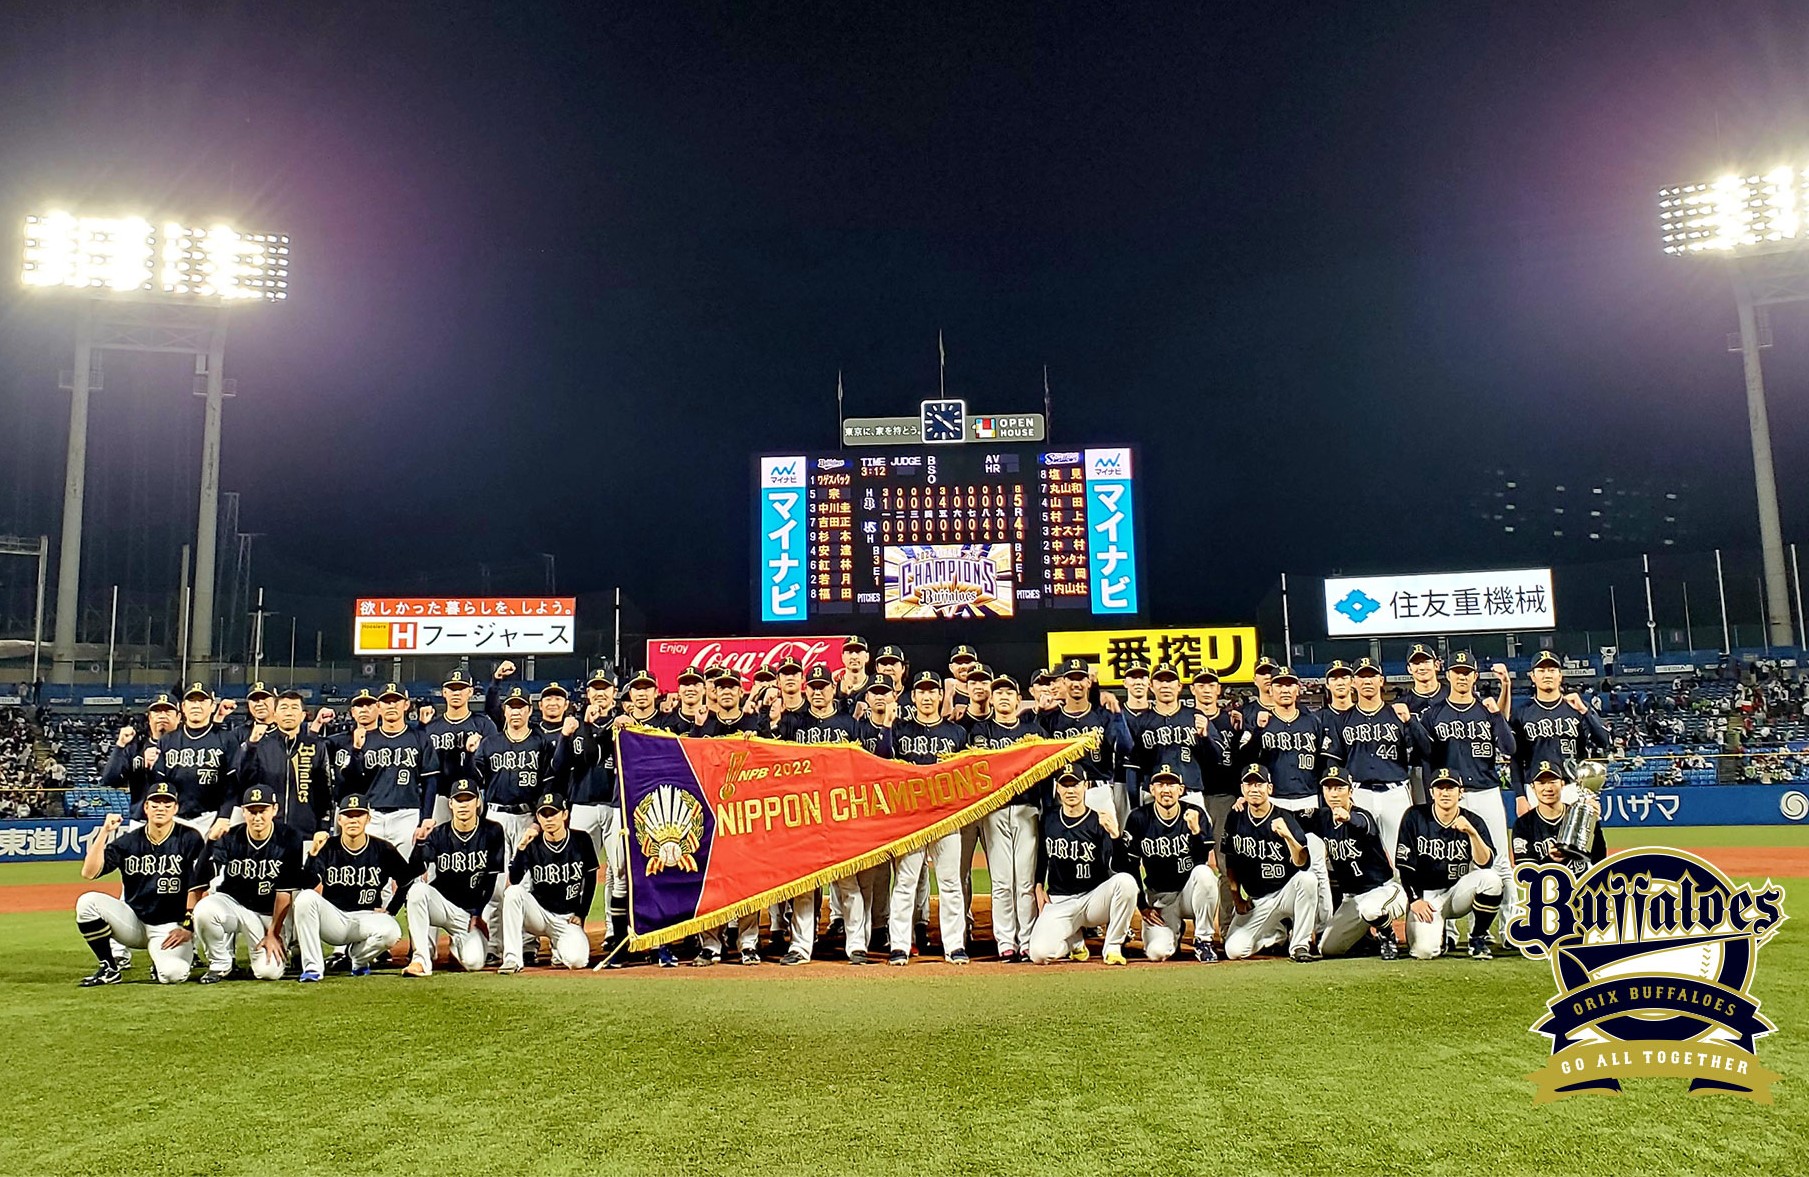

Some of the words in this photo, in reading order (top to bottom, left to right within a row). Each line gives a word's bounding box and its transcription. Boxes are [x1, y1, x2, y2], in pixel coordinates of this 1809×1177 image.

[1000, 418, 1034, 428] OPEN
[845, 426, 921, 438] 東京に、家を持とう。
[1000, 428, 1034, 437] HOUSE
[861, 457, 886, 466] TIME
[890, 456, 921, 465] JUDGE
[927, 456, 936, 465] B
[985, 454, 1000, 463] AV
[861, 467, 886, 476] 3:12
[927, 466, 936, 474] S
[985, 464, 1000, 473] HR
[1040, 470, 1047, 479] 8
[1048, 468, 1083, 480] 塩見
[1095, 468, 1122, 476] マイナビ
[770, 476, 797, 484] マイナビ
[810, 476, 815, 485] 1
[927, 475, 937, 484] O
[810, 490, 816, 499] 5
[828, 488, 840, 499] 宗
[1041, 484, 1047, 493] 7
[1049, 483, 1083, 494] 丸山和
[810, 503, 816, 512] 3
[819, 502, 851, 513] 中川圭
[882, 498, 890, 509] 1
[895, 498, 904, 509] 0
[910, 498, 918, 508] 0
[924, 497, 932, 508] 0
[939, 497, 947, 508] 4
[953, 497, 961, 508] 0
[967, 496, 975, 508] 0
[981, 496, 990, 507] 0
[995, 496, 1004, 507] 0
[1013, 494, 1023, 506] 5
[1041, 498, 1048, 507] 4
[1050, 497, 1083, 508] 山田
[1014, 508, 1022, 517] R
[1042, 512, 1048, 521] 5
[1050, 511, 1084, 523] 村上
[810, 518, 816, 527] 7
[818, 517, 851, 528] 吉田正
[882, 521, 891, 532] 0
[896, 521, 904, 532] 0
[910, 521, 919, 532] 0
[925, 520, 933, 531] 0
[939, 520, 948, 531] 0
[953, 520, 962, 531] 0
[968, 520, 976, 530] 0
[982, 520, 990, 530] 4
[996, 519, 1004, 530] 0
[1014, 520, 1023, 530] 4
[810, 532, 816, 541] 9
[818, 531, 852, 542] 杉本
[1042, 527, 1049, 536] 3
[1050, 525, 1085, 537] オスナ
[811, 547, 816, 556] 4
[873, 546, 880, 555] B
[1015, 542, 1022, 552] B
[1043, 541, 1049, 550] 2
[1051, 539, 1085, 551] 中村
[1093, 484, 1131, 609] マイナビ
[767, 492, 800, 616] マイナビ
[873, 556, 880, 565] 3
[1015, 552, 1022, 562] 2
[1043, 555, 1050, 564] 9
[1051, 553, 1086, 565] サンタナ
[811, 561, 817, 570] 6
[819, 559, 852, 571] 紅林
[873, 567, 880, 576] E
[1015, 564, 1023, 573] E
[811, 576, 817, 585] 2
[819, 574, 852, 585] 若月
[901, 559, 995, 599] CHAMPIONS
[1016, 574, 1022, 583] 1
[1044, 569, 1050, 579] 6
[1052, 567, 1087, 580] 長岡
[874, 577, 880, 586] 1
[1044, 584, 1051, 594] H
[1053, 582, 1088, 595] 内山壮
[811, 590, 817, 599] 8
[819, 588, 852, 600] 福田
[857, 593, 881, 603] PITCHES
[919, 588, 978, 606] Buffaloes
[1016, 589, 1040, 600] PITCHES
[360, 600, 573, 616] 欲しかった暮らしを、しよう。
[1389, 584, 1547, 620] 住友重機械
[391, 623, 414, 649] H
[423, 622, 569, 648] フージャース
[659, 642, 688, 655] Enjoy
[690, 640, 831, 675] Coca-Cl
[1342, 722, 1399, 746] ORIX
[1435, 720, 1492, 741] ORIX
[1523, 717, 1580, 741] ORIX
[898, 733, 957, 755] ORIX
[1141, 727, 1198, 749] ORIX
[1261, 731, 1317, 753] ORIX
[1181, 746, 1191, 762] 2
[1375, 744, 1397, 760] 44
[1471, 742, 1493, 758] 29
[1560, 739, 1578, 755] 21
[165, 747, 224, 769] ORIX
[364, 745, 419, 768] ORIX
[490, 749, 541, 773] ORIX
[1298, 753, 1315, 770] 10
[297, 742, 317, 804] Buffaloes
[739, 767, 769, 781] NPB
[773, 760, 812, 778] 2022
[1160, 764, 1171, 774] B
[196, 769, 219, 784] 75
[397, 769, 410, 785] 9
[518, 771, 537, 787] 36
[157, 782, 168, 794] B
[250, 789, 262, 801] B
[349, 796, 359, 808] B
[717, 790, 823, 838] NIPPON
[829, 760, 993, 821] CHAMPIONS
[1603, 791, 1680, 821] ハザマ
[1141, 833, 1190, 858] ORIX
[1233, 834, 1284, 861] ORIX
[1416, 835, 1468, 860] ORIX
[124, 854, 183, 875] ORIX
[437, 850, 488, 873] ORIX
[1177, 857, 1194, 873] 16
[227, 858, 283, 880] ORIX
[326, 865, 381, 885] ORIX
[533, 860, 584, 884] ORIX
[1075, 863, 1091, 879] 11
[1261, 864, 1285, 879] 20
[1350, 861, 1363, 877] 1
[1448, 863, 1470, 880] 50
[156, 877, 181, 894] 99
[565, 884, 580, 899] 19
[358, 889, 376, 905] 18
